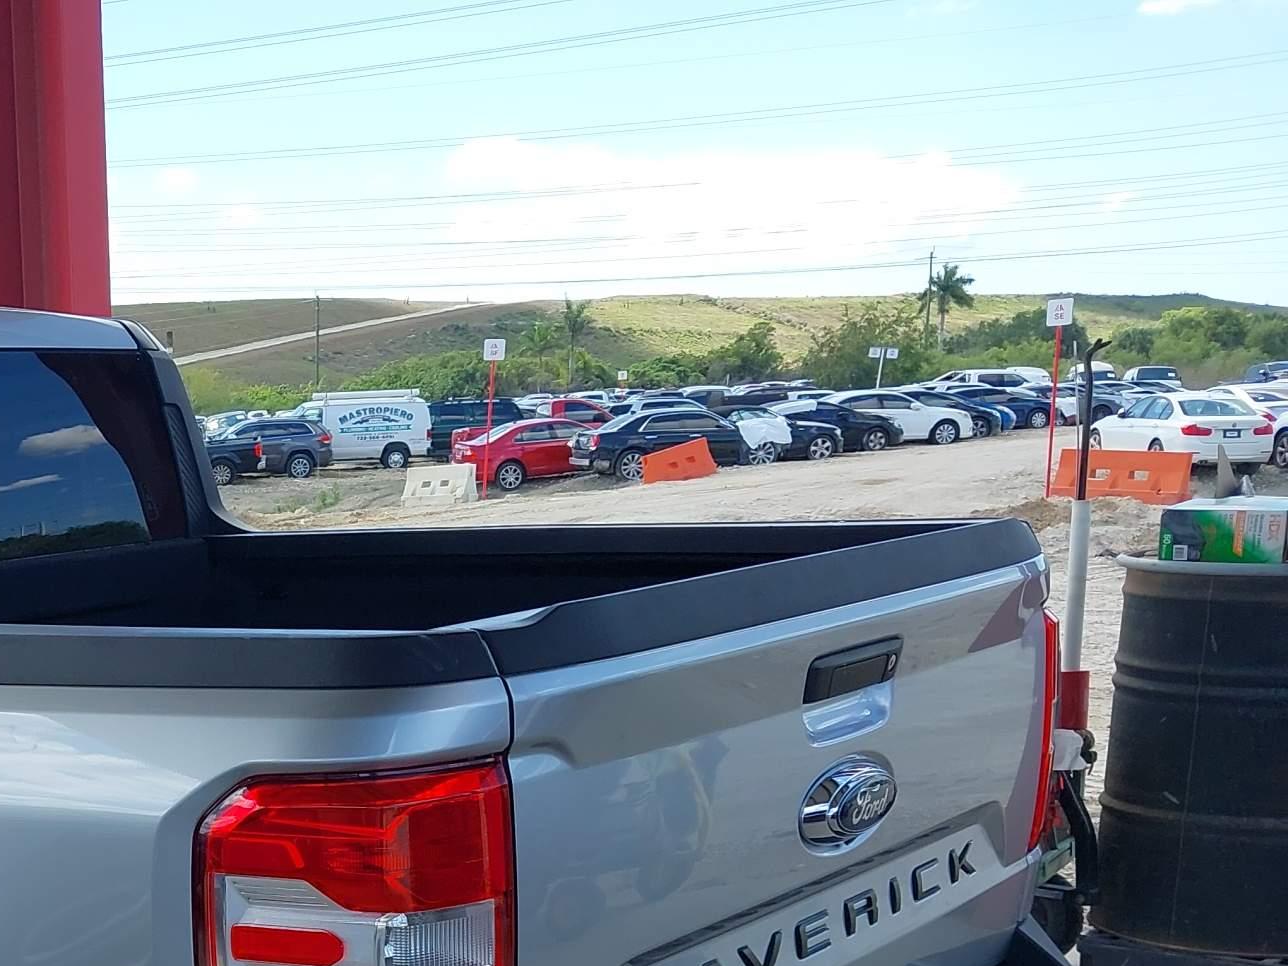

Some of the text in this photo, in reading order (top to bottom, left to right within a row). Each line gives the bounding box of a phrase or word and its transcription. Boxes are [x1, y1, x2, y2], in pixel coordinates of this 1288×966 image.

[338, 406, 414, 425] MASTROPIERO
[1268, 513, 1281, 541] HDX
[852, 783, 889, 825] Ford
